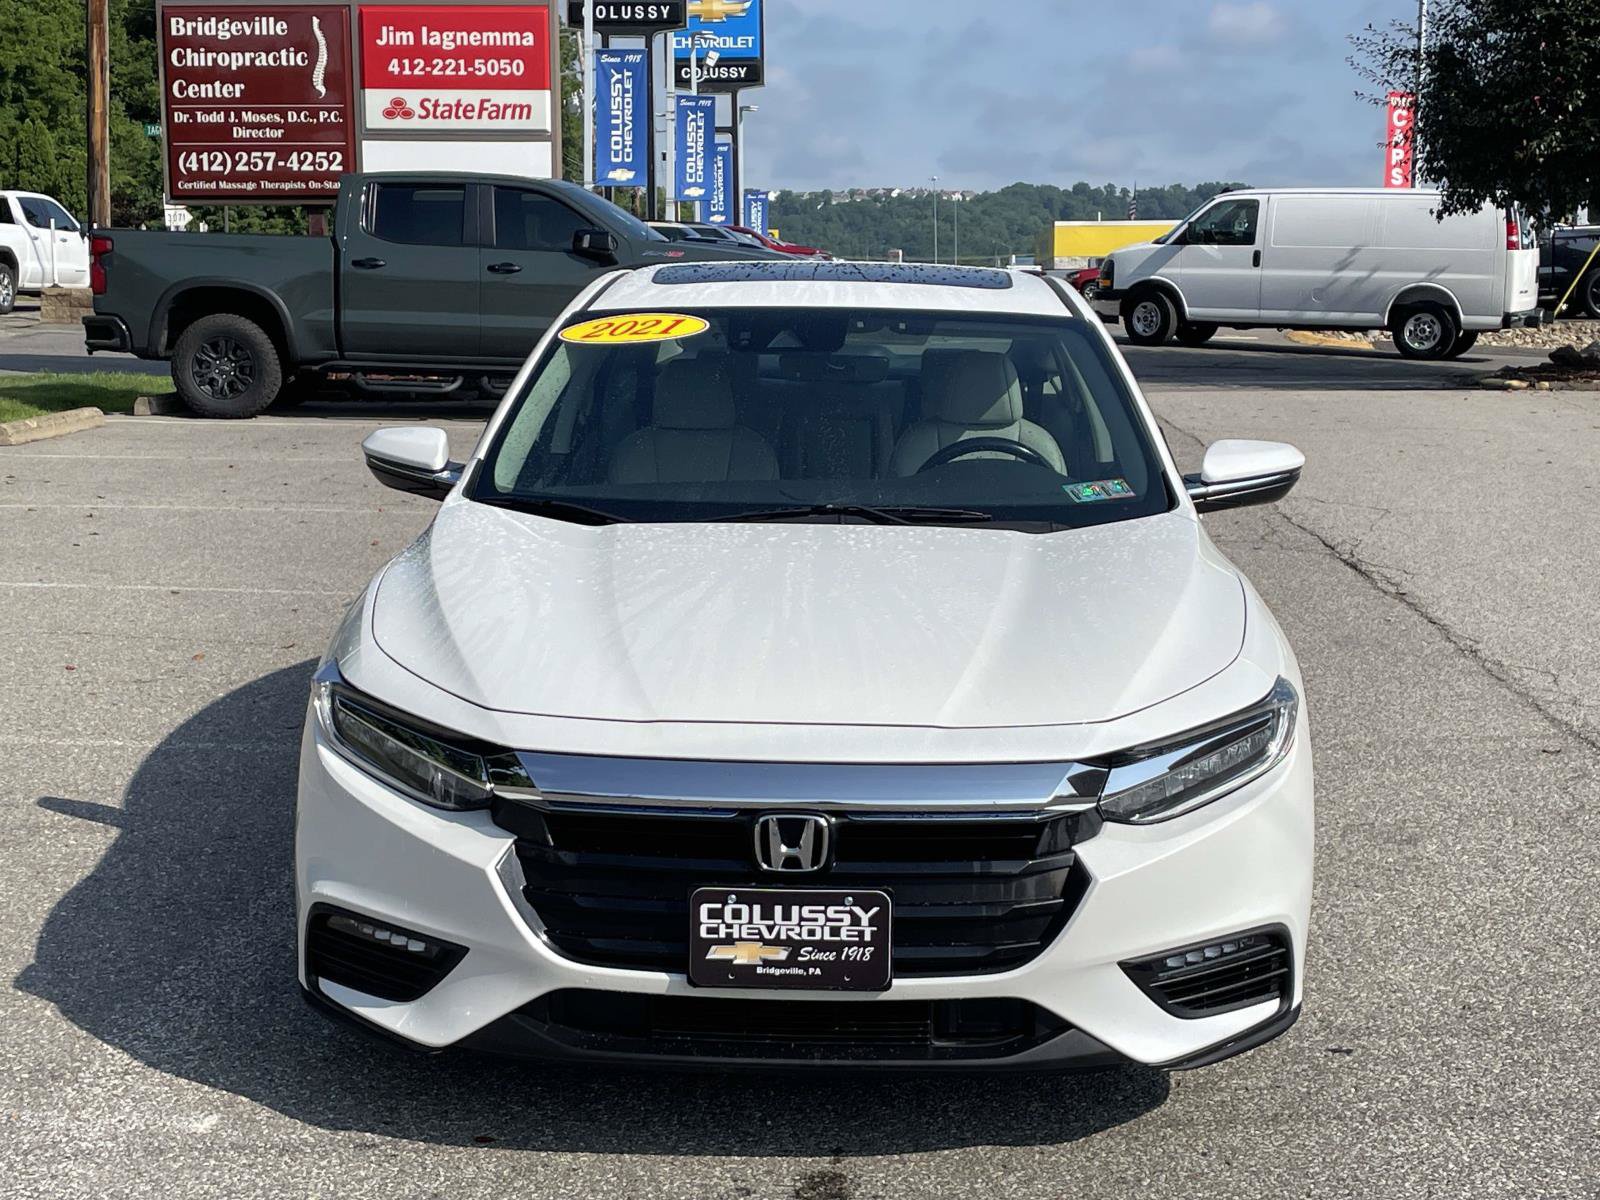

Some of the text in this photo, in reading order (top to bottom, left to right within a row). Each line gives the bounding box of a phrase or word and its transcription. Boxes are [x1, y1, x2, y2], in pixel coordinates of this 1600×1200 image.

[582, 5, 670, 19] OLUSSY
[170, 16, 288, 40] Bridgeville
[376, 26, 535, 50] Jim Iagnemma
[672, 36, 755, 48] CHEVROLET
[170, 47, 308, 70] Chiropractic
[388, 58, 525, 76] 412-221-5050
[600, 54, 642, 63] Since 1918
[172, 79, 245, 98] Center
[174, 111, 343, 124] Dr. Todd J. Moses, D.C., P.C.
[610, 69, 623, 163] COLUSSY
[623, 69, 633, 162] CHEVROLET
[232, 126, 285, 139] Director
[686, 110, 697, 183] COLUSSY
[696, 111, 704, 183] CHEVROLET
[178, 180, 217, 190] Certified
[218, 180, 257, 191] Massage
[260, 180, 306, 191] Therapists
[581, 319, 686, 338] 2021
[700, 903, 880, 927] COLUSSY
[700, 923, 877, 942] CHEVROLET
[797, 946, 875, 962] Since 1918
[756, 966, 822, 976] Bridgeville, PA
